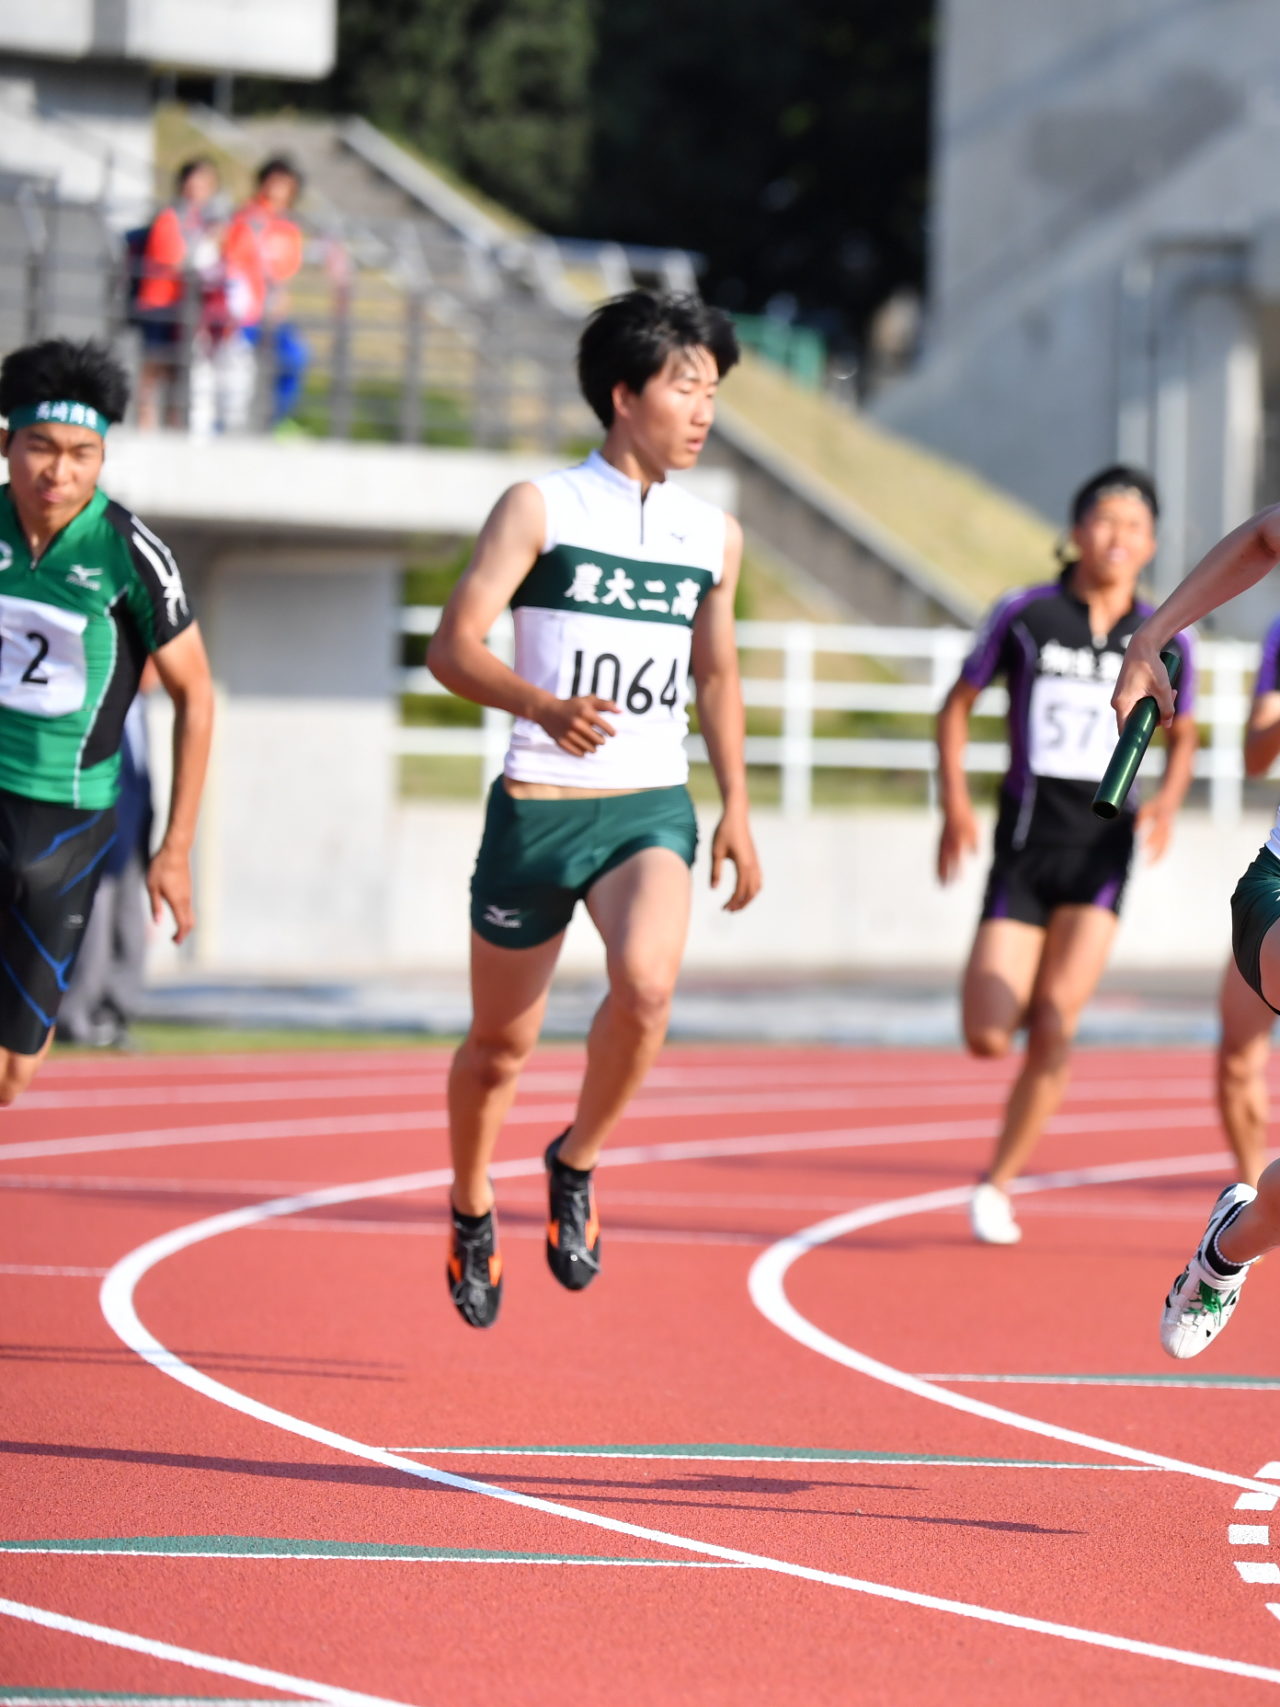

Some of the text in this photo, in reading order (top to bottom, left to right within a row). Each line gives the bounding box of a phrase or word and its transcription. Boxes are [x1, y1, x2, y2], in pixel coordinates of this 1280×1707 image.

[565, 562, 701, 621] 農大二高
[571, 650, 677, 715] 1064
[1043, 702, 1118, 752] 57
